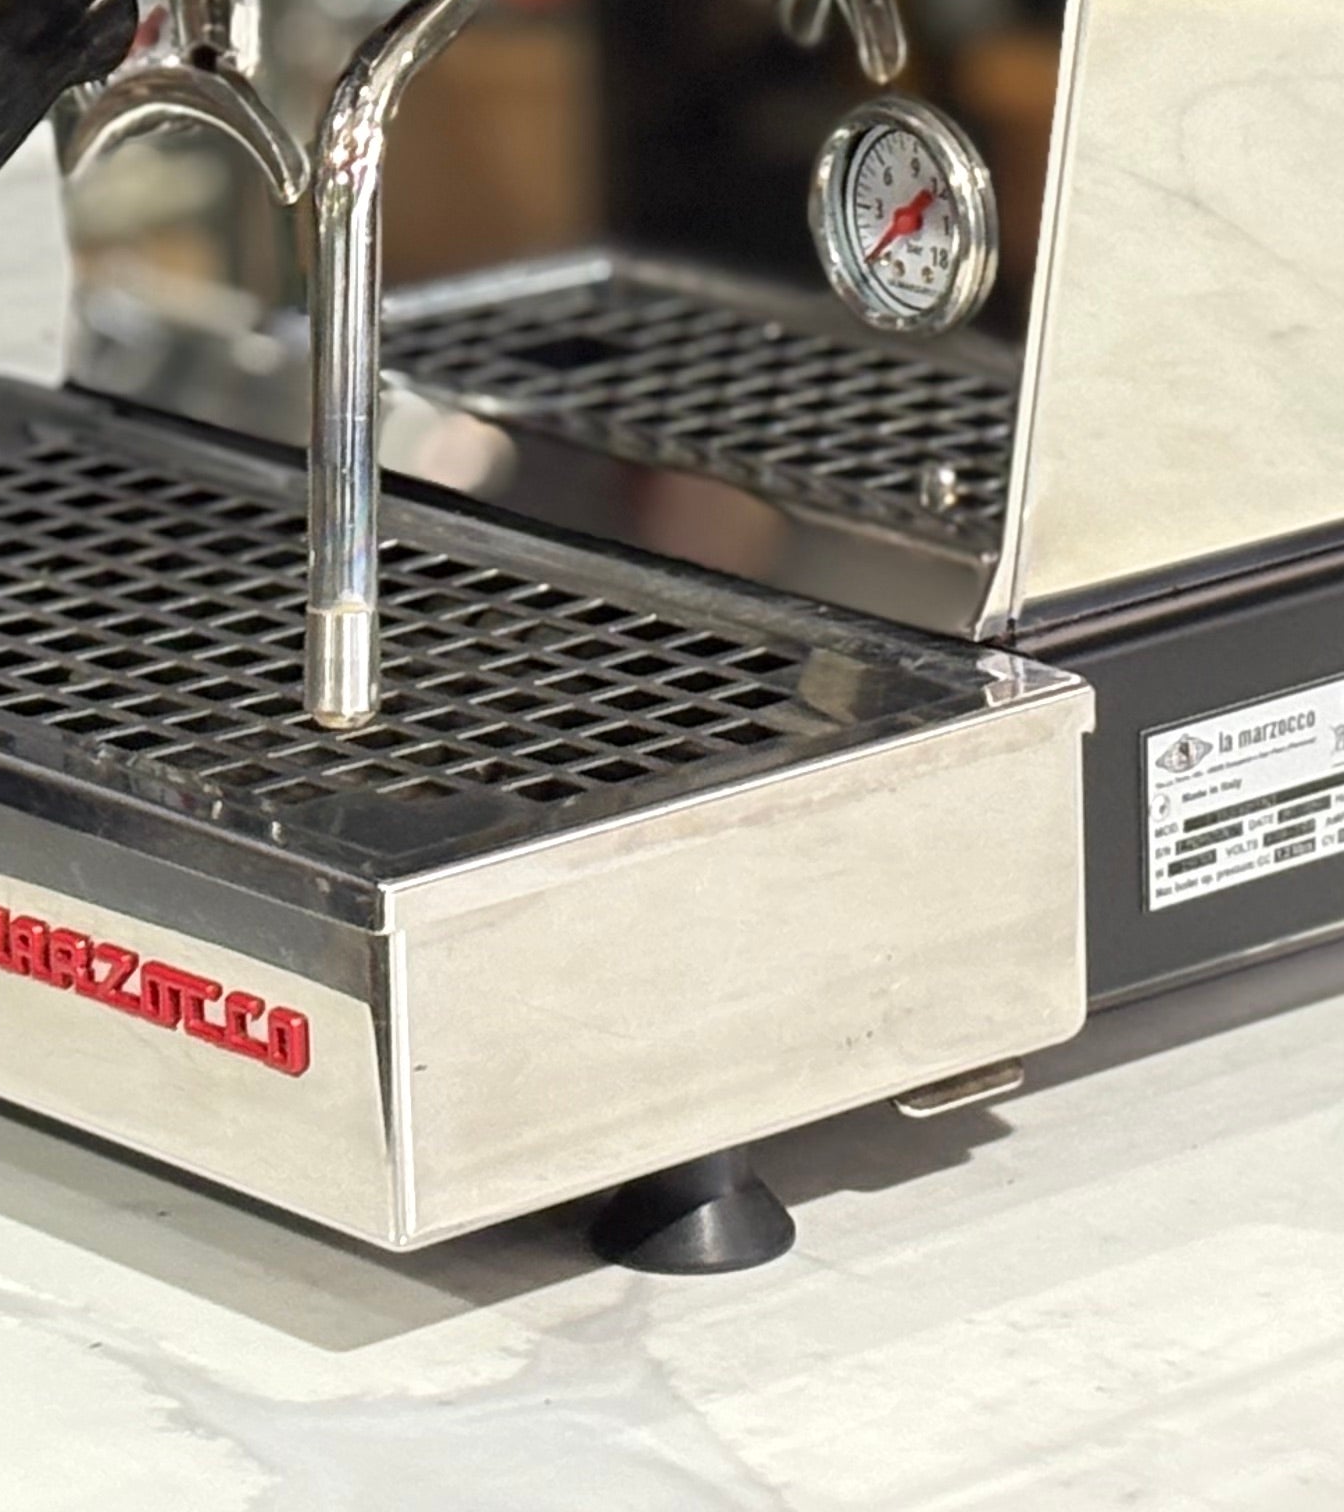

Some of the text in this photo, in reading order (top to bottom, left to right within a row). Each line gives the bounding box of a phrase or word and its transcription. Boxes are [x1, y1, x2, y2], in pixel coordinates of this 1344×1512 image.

[883, 165, 893, 187] 6
[910, 156, 921, 179] 9
[874, 197, 884, 220] 3
[930, 246, 949, 270] 18
[1218, 730, 1233, 754] la
[1238, 709, 1316, 748] marzocco
